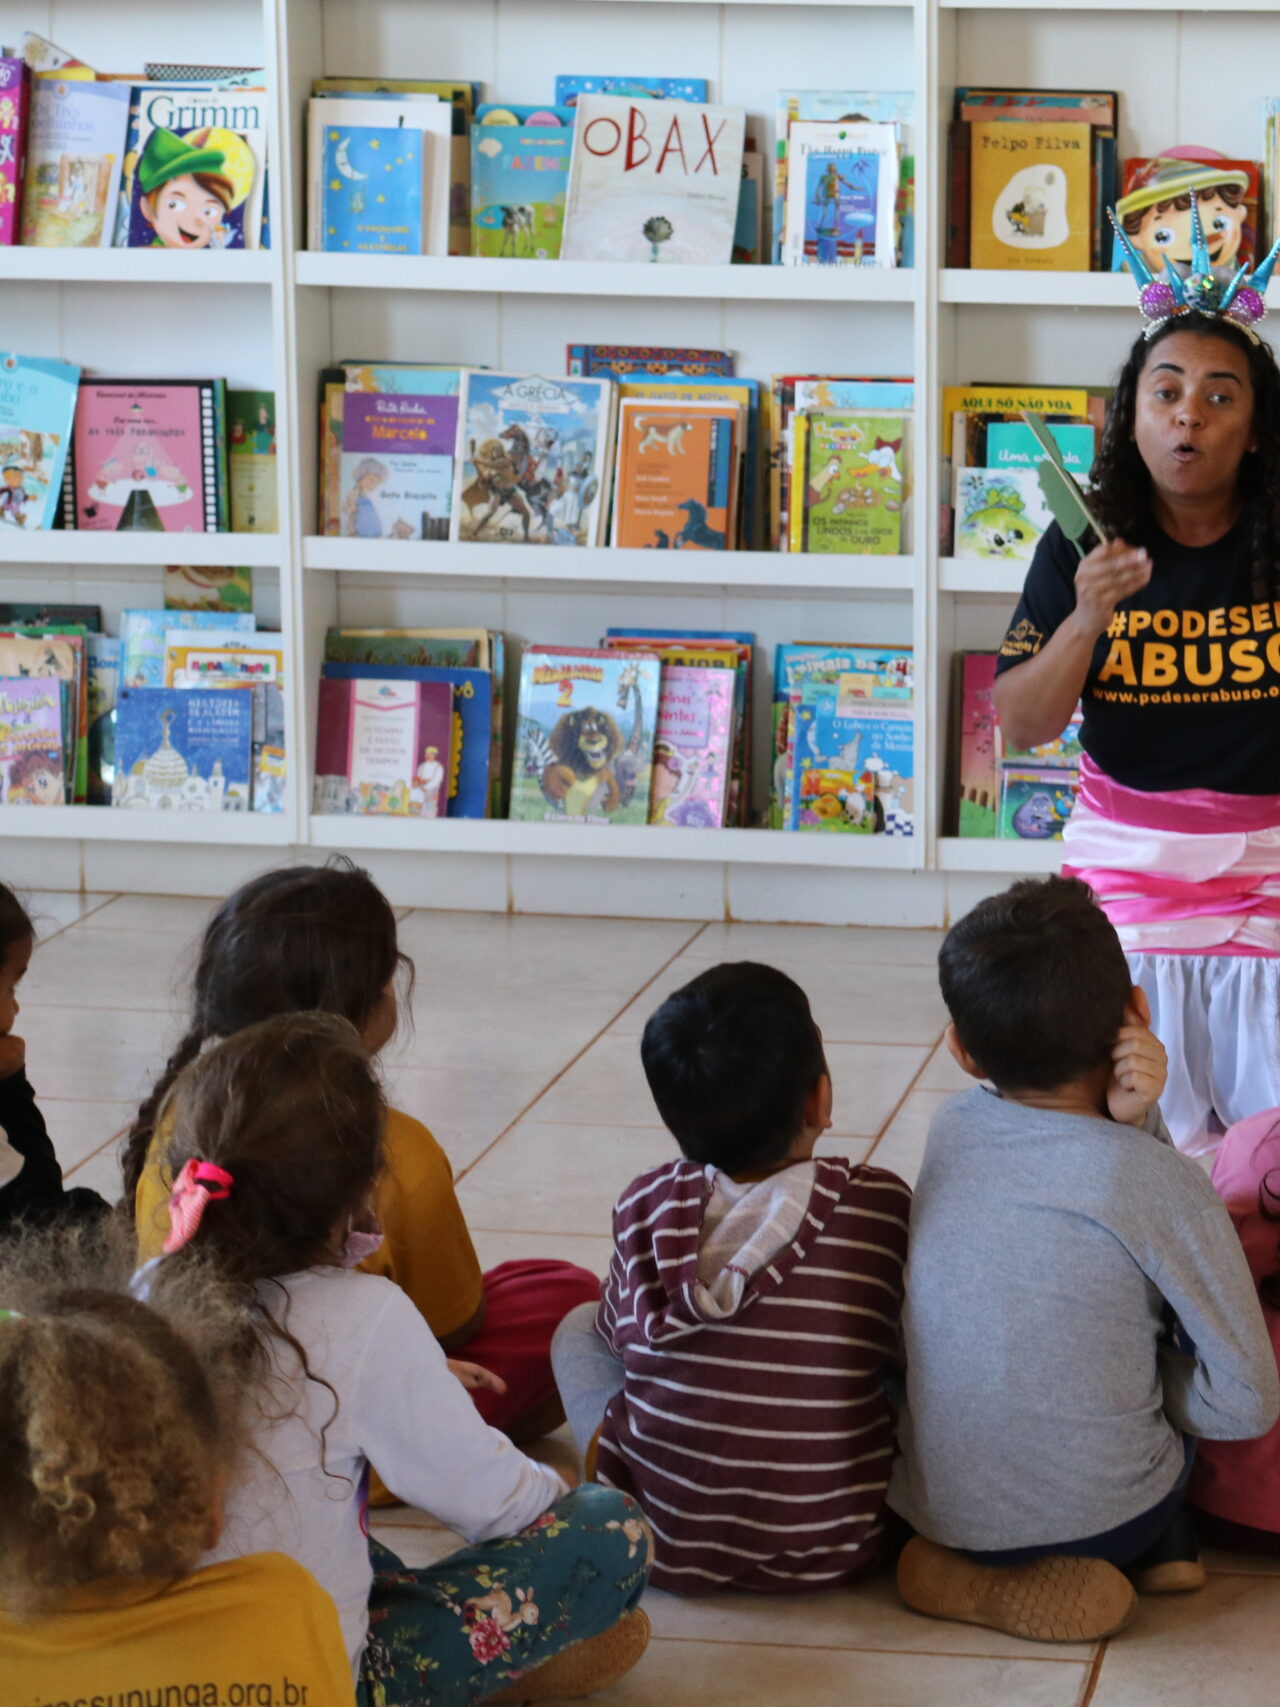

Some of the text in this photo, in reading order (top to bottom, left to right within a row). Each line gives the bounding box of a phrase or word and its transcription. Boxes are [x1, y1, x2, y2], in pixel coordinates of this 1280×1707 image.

[146, 96, 260, 130] Grimm
[584, 106, 727, 176] OBAX
[982, 136, 1080, 151] Felpo Filva
[516, 381, 566, 401] GRÉCIA
[961, 395, 1073, 410] AQUI SÓ NÃO VOA
[372, 424, 429, 441] Marcelo
[998, 450, 1031, 464] Uma
[557, 680, 573, 707] 2
